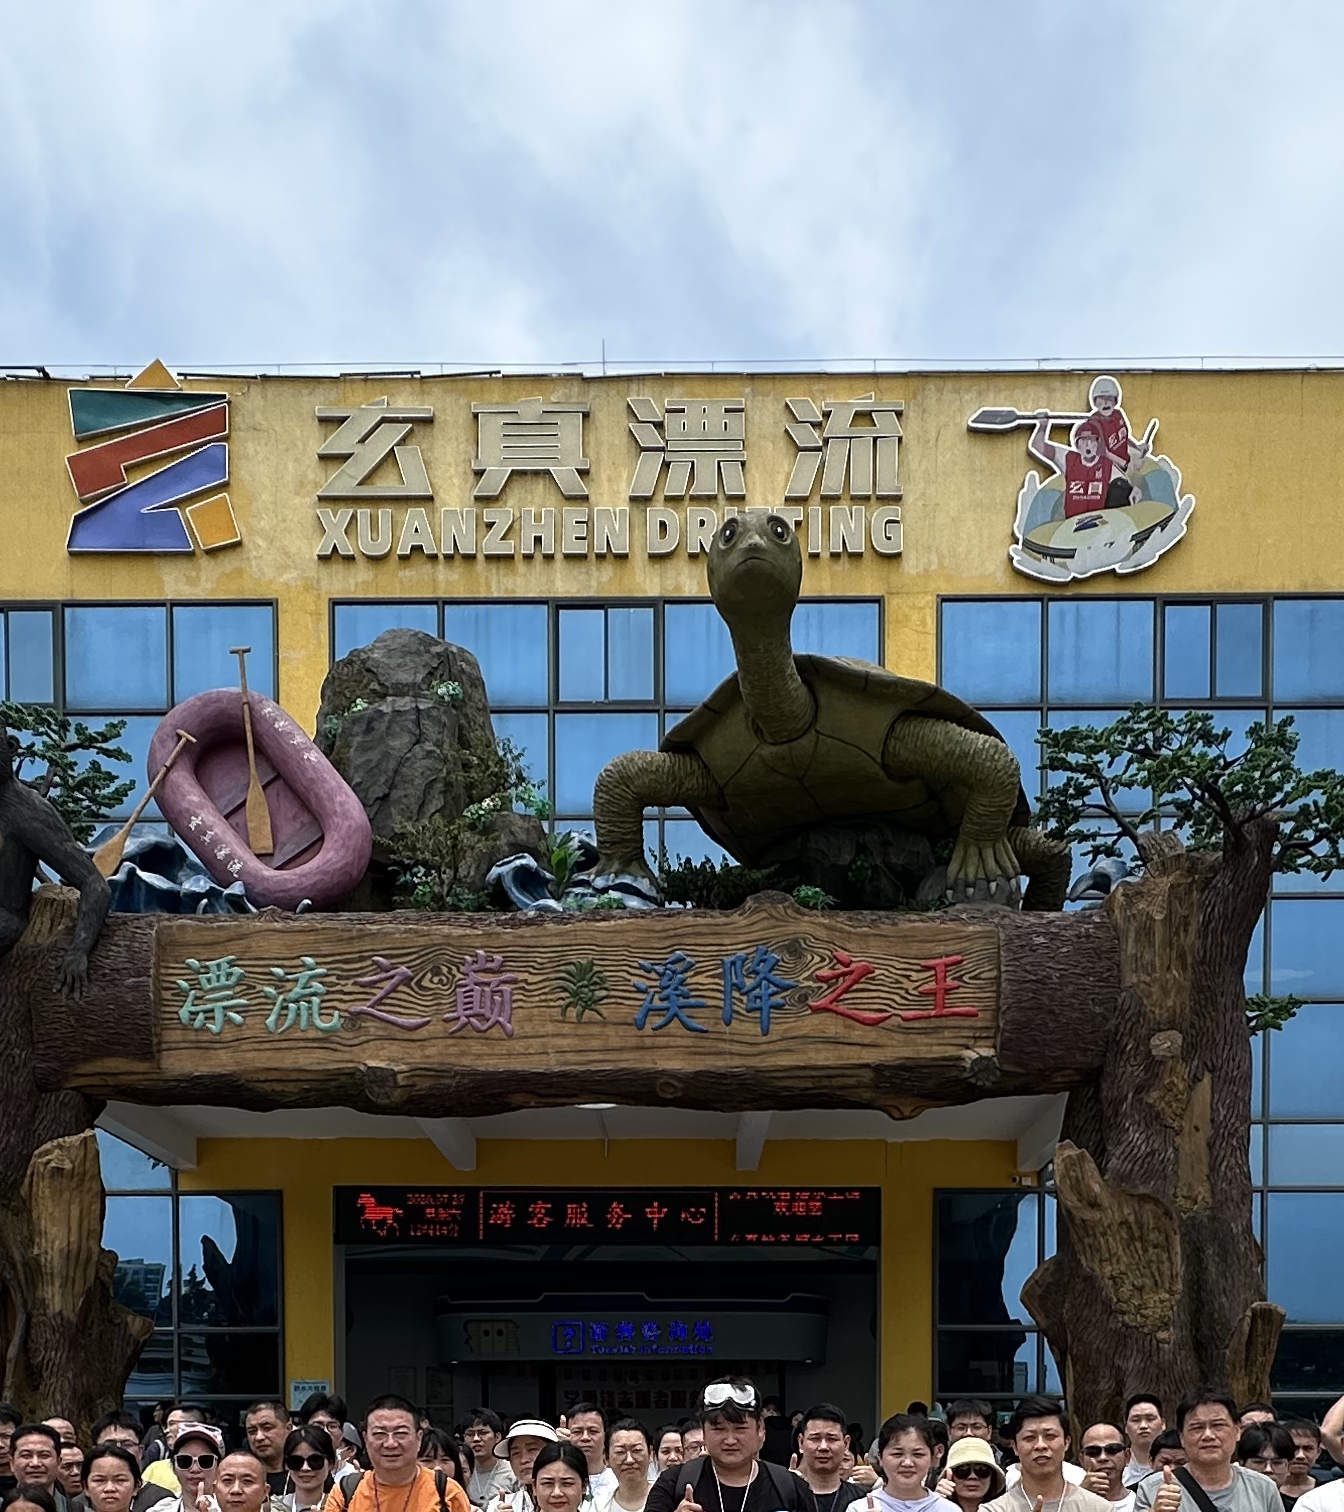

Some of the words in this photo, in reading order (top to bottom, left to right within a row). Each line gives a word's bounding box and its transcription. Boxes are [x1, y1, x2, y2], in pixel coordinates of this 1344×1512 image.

[315, 392, 904, 500] 玄真漂流
[316, 507, 630, 559] XUANZHEN
[175, 949, 520, 1038] 漂流之巅
[631, 945, 981, 1038] 溪降之王
[487, 1200, 707, 1234] 游客服务中心
